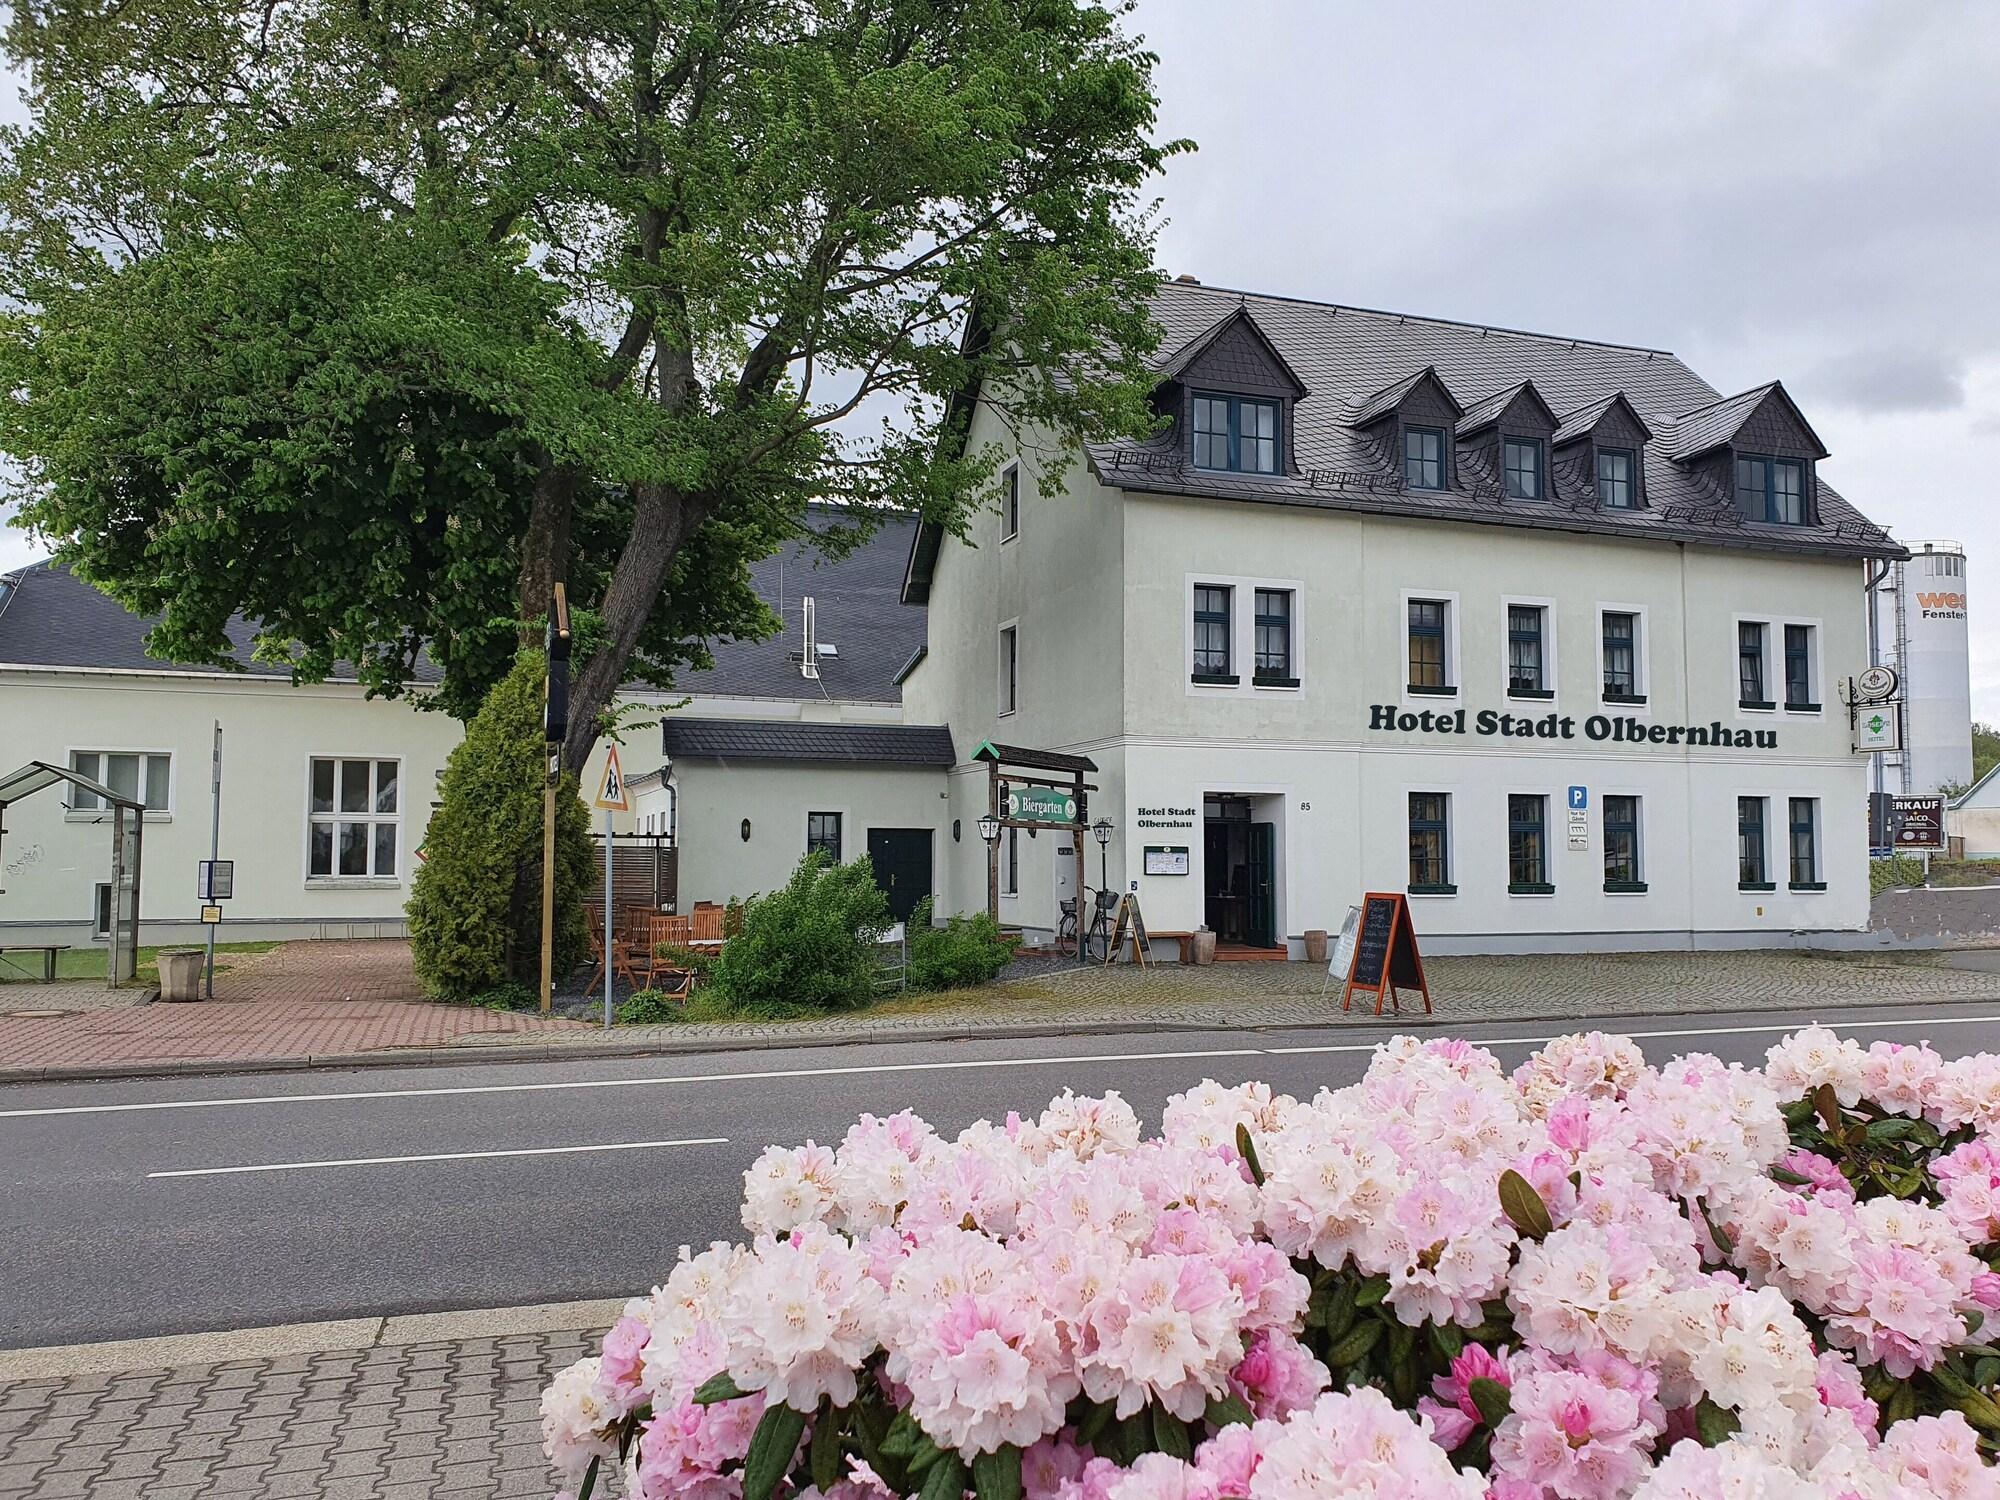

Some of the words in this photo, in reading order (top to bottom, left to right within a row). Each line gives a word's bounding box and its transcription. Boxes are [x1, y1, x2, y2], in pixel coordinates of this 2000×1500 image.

[1368, 704, 1466, 734] Hotel
[1475, 710, 1575, 739] Stadt
[1584, 715, 1778, 749] Olbernhau
[1574, 790, 1582, 804] P
[1022, 797, 1062, 817] Biergarten
[1137, 808, 1165, 816] Hotel
[1167, 808, 1196, 816] Stadt
[1300, 802, 1311, 811] 85
[1137, 820, 1193, 828] Olbernhau
